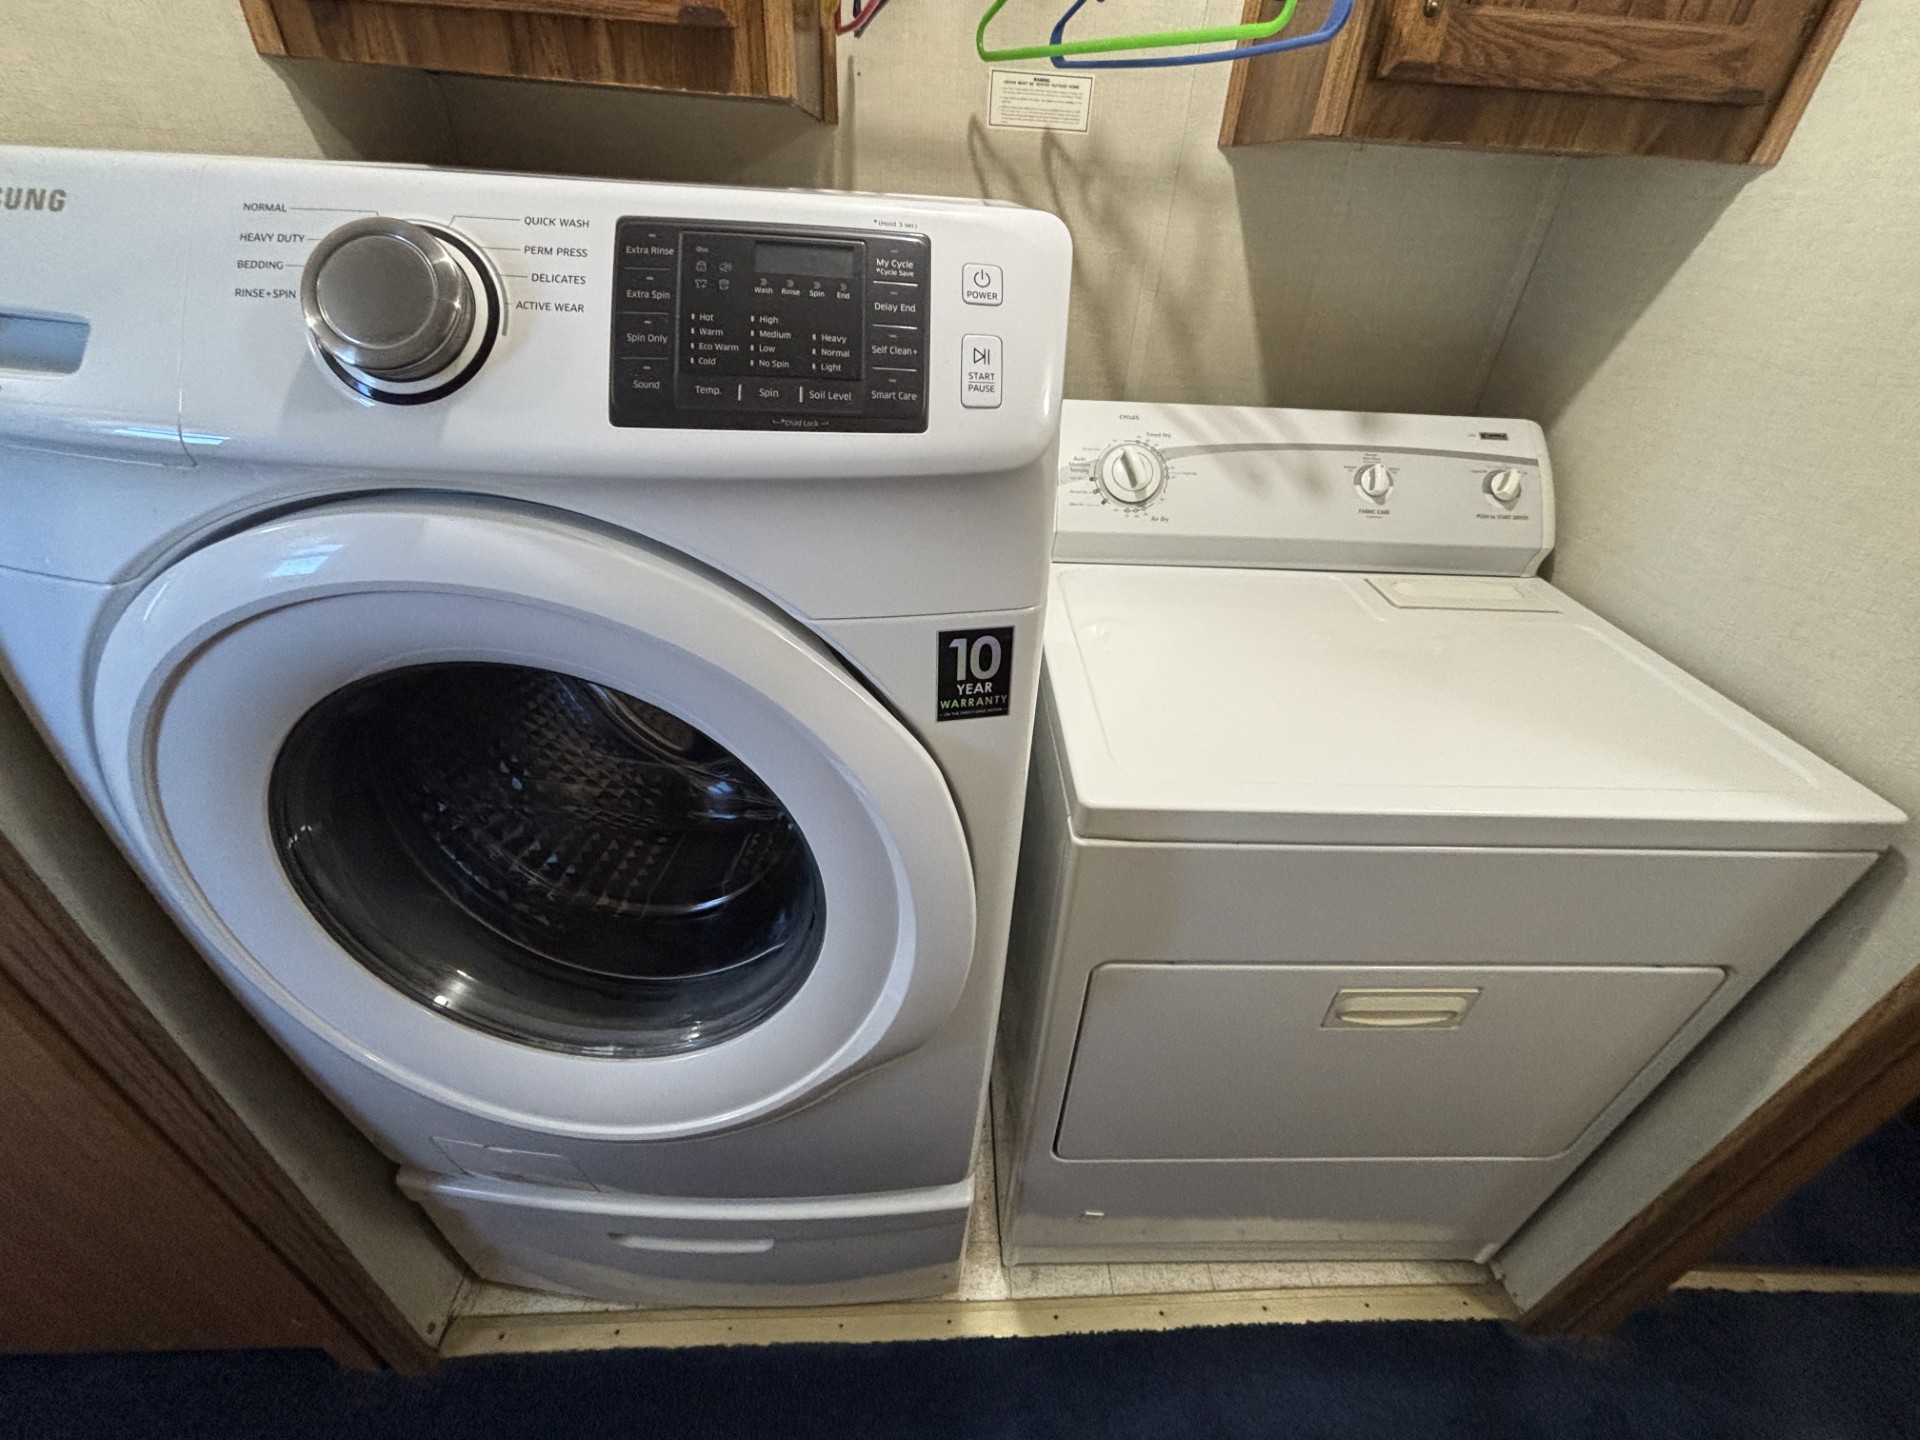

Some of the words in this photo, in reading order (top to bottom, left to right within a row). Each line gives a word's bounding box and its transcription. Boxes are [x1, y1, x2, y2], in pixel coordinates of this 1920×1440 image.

[0, 187, 66, 212] UNG
[243, 203, 287, 212] NORMAL
[524, 216, 556, 226] QUICK
[560, 218, 590, 228] WASH
[240, 233, 274, 242] HEAVY
[277, 234, 305, 243] DUTY
[524, 246, 553, 255] PERM
[556, 247, 588, 257] PRESS
[626, 245, 649, 254] Extra
[651, 246, 674, 255] Rinse
[237, 260, 284, 269] BEDDING
[876, 258, 889, 268] My
[891, 259, 914, 269] Cycle
[899, 269, 915, 277] Save
[531, 273, 586, 284] DELICATES
[235, 288, 296, 299] RINSE+SPIN
[626, 289, 649, 299] Extra
[652, 290, 670, 300] Spin
[754, 286, 773, 294] Wash
[781, 288, 800, 296] Rinse
[809, 290, 825, 298] Spin
[836, 292, 850, 300] End
[966, 290, 998, 300] POWER
[516, 300, 552, 311] ACTIVE
[554, 302, 584, 312] WEAR
[874, 302, 898, 313] Delay
[900, 303, 916, 312] End
[699, 313, 714, 321] Hot
[759, 316, 779, 325] High
[699, 328, 723, 336] Warm
[759, 330, 791, 339] Medium
[626, 333, 646, 344] Spin
[647, 334, 668, 344] Only
[822, 334, 847, 344] Heavy
[699, 342, 713, 351] Eco
[714, 343, 739, 351] Warm
[759, 345, 776, 353] Low
[872, 345, 888, 354] Self
[821, 348, 850, 358] Normal
[698, 357, 716, 366] Cold
[772, 360, 790, 369] Spin
[821, 363, 842, 372] Light
[968, 372, 995, 381] START
[633, 380, 660, 389] Sound
[968, 384, 995, 393] PAUSE
[759, 388, 779, 398] Spin
[809, 390, 825, 399] Soil
[828, 391, 852, 401] Level
[872, 390, 896, 400] Smart
[898, 391, 917, 400] Care
[948, 635, 1002, 681] 10
[956, 682, 993, 695] YEAR
[940, 694, 1008, 710] WARRANTY
